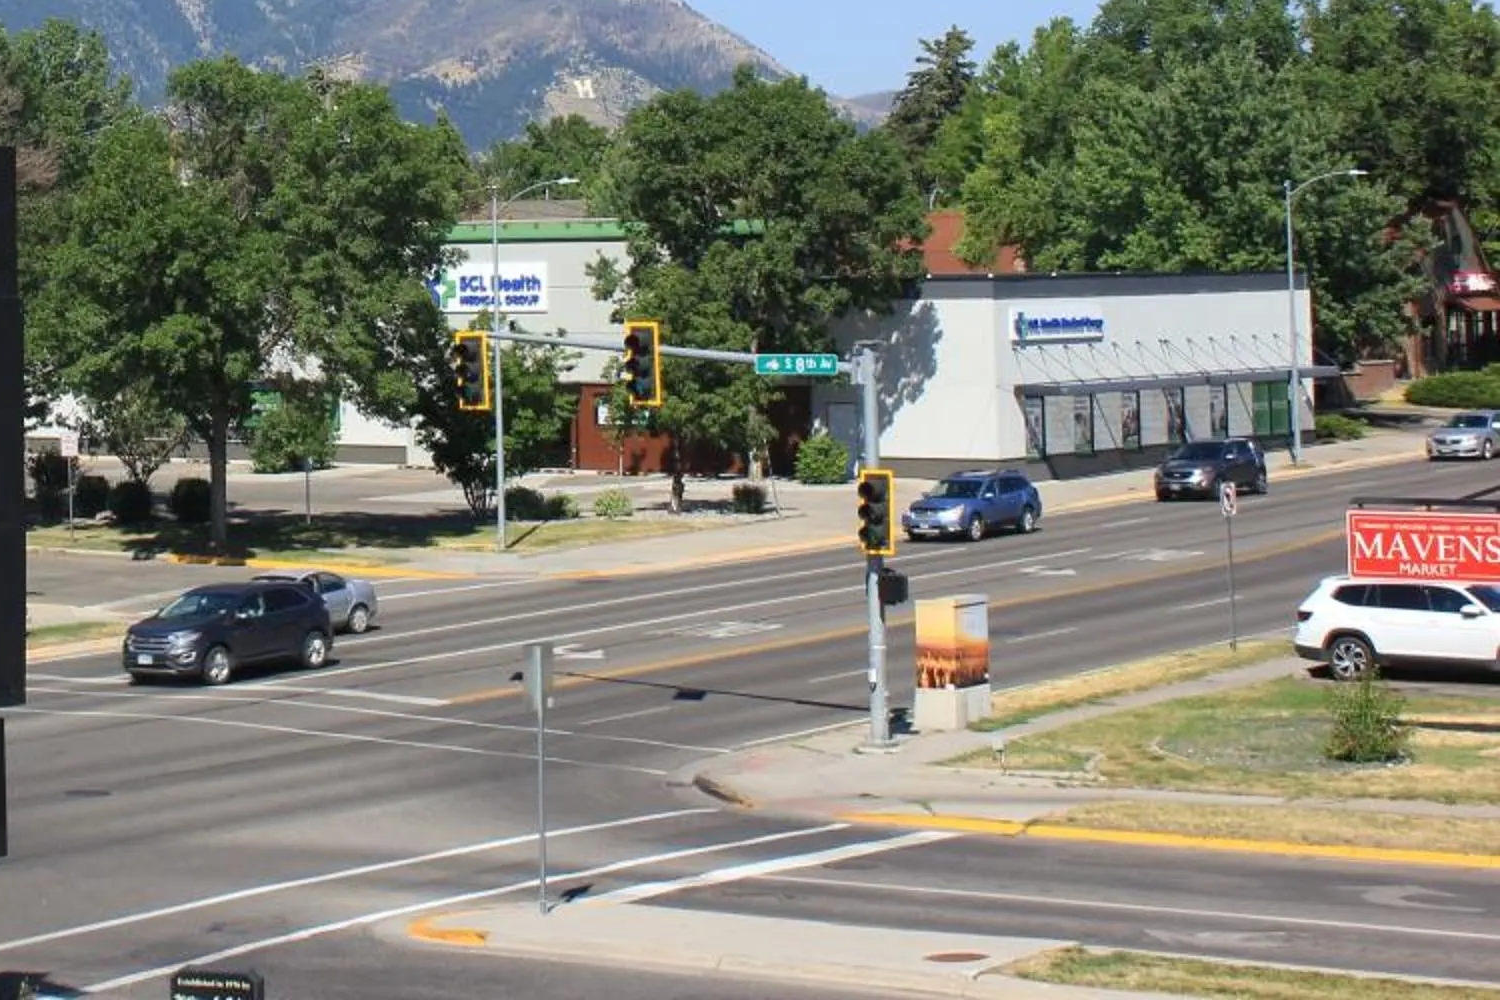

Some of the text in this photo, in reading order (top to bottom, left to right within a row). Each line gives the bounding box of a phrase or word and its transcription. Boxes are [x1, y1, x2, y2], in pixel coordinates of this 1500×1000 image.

[459, 273, 541, 292] SCL Health
[785, 357, 793, 370] S
[1352, 530, 1500, 564] MAVENS
[1399, 562, 1457, 578] MARKET
